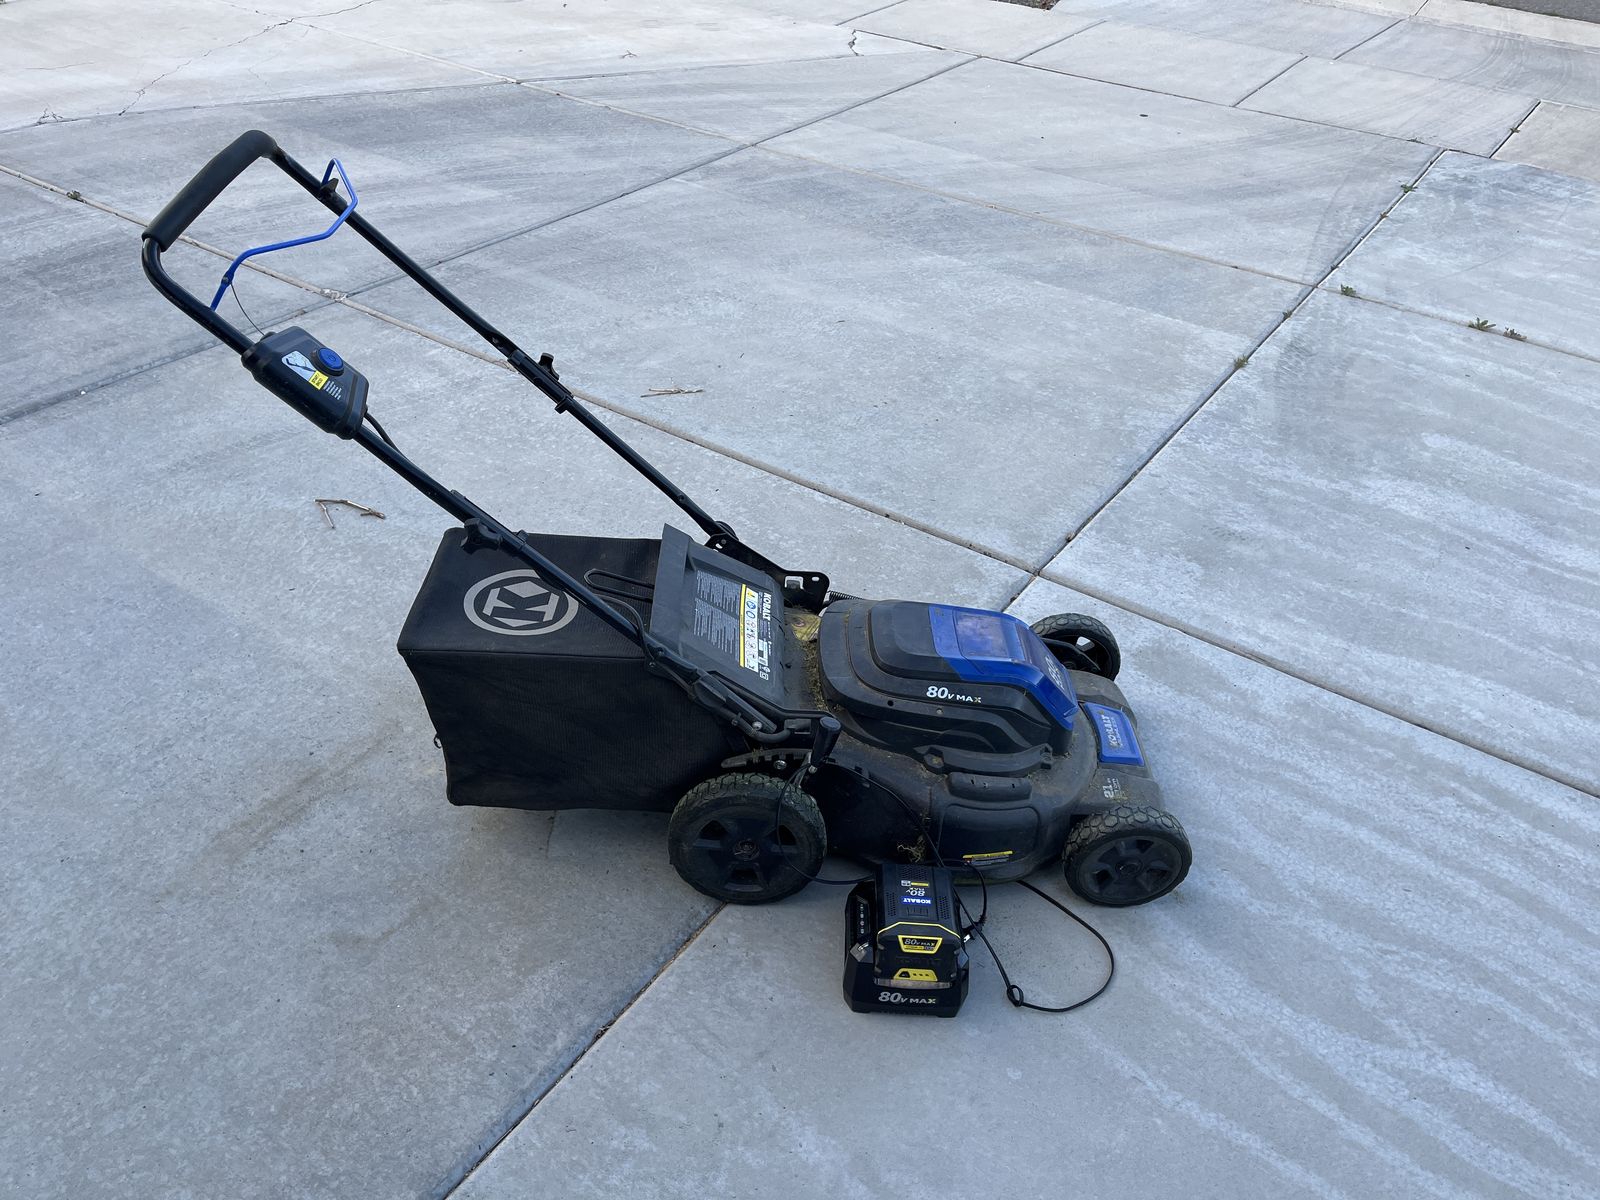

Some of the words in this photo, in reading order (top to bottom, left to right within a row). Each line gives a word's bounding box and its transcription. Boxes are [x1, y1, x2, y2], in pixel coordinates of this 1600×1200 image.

[763, 592, 772, 622] KOBALT
[956, 694, 982, 704] MAX
[1102, 784, 1114, 799] 21
